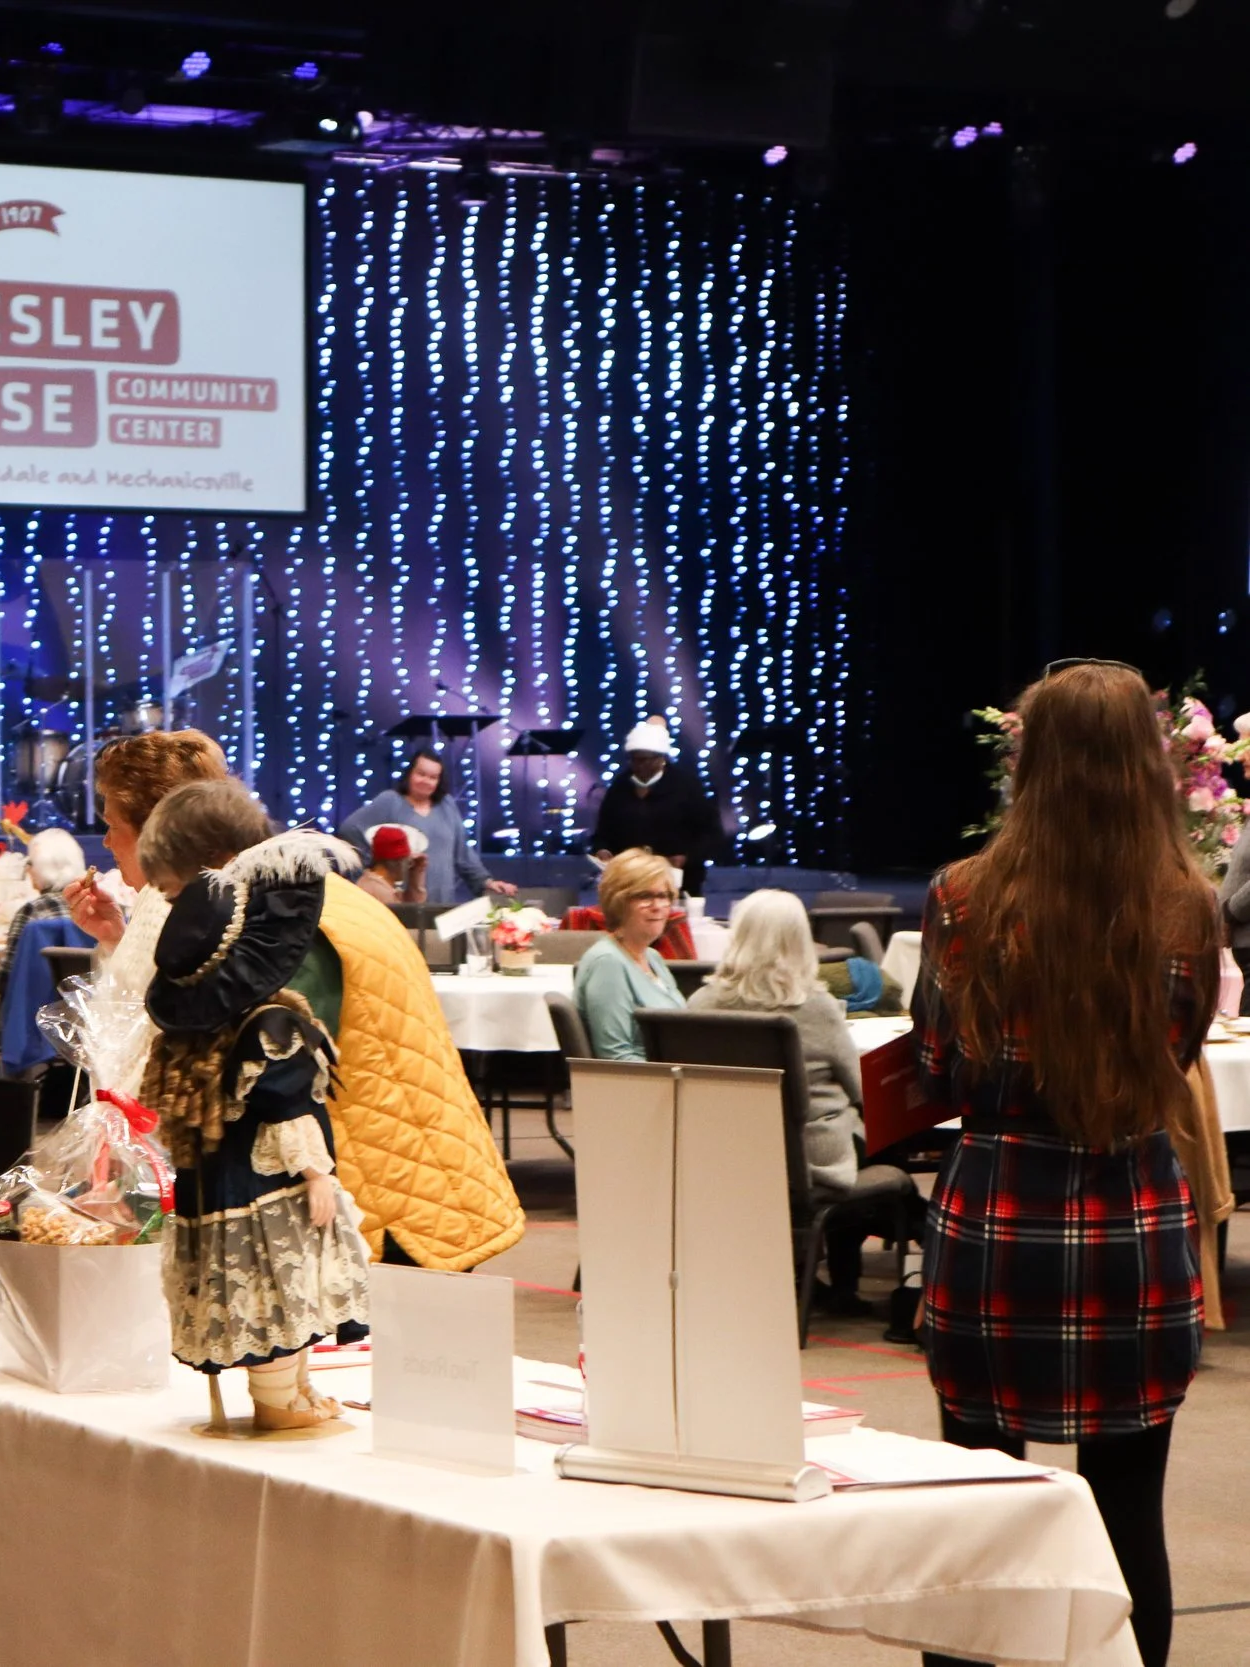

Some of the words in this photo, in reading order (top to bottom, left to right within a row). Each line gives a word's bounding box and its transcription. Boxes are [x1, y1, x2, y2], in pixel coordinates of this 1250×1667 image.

[1, 205, 43, 225] 1907
[115, 377, 270, 405] COMMUNITY
[115, 418, 214, 443] CENTER
[57, 468, 97, 485] and
